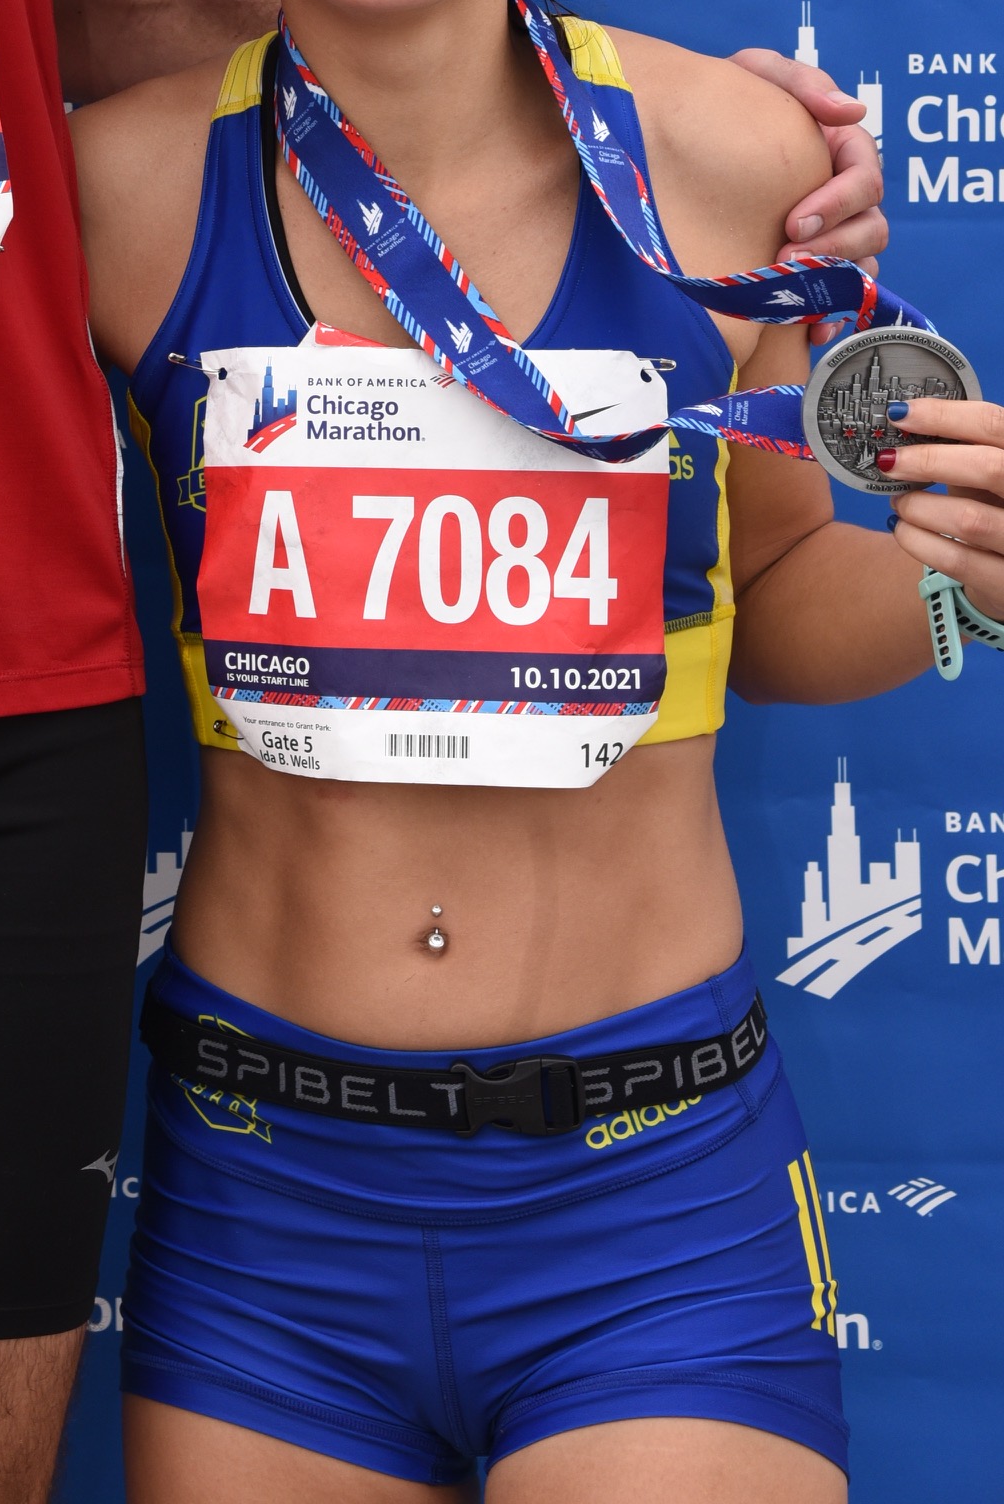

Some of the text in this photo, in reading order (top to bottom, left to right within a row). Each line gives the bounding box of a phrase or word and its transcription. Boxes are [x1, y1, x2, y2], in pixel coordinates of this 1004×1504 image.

[909, 54, 996, 74] BANK
[828, 333, 966, 371] BANK OF AMERICA CHICAGO MARATHON
[308, 378, 426, 387] BANK OF AMERICA
[307, 395, 398, 421] Chicago
[249, 491, 617, 625] A 7084
[225, 653, 309, 675] CHICAGO
[227, 673, 308, 687] IS YOUR START LINE
[511, 667, 640, 689] 10.10.2021
[243, 716, 256, 725] Your
[258, 718, 285, 729] entrance
[296, 722, 313, 730] Grant
[315, 724, 331, 732] Park:
[262, 731, 312, 753] Gate 5
[260, 750, 320, 770] Ida B. Wells
[581, 743, 623, 767] 142
[583, 1015, 765, 1106] SPIBEL
[197, 1038, 463, 1118] SPIBELT
